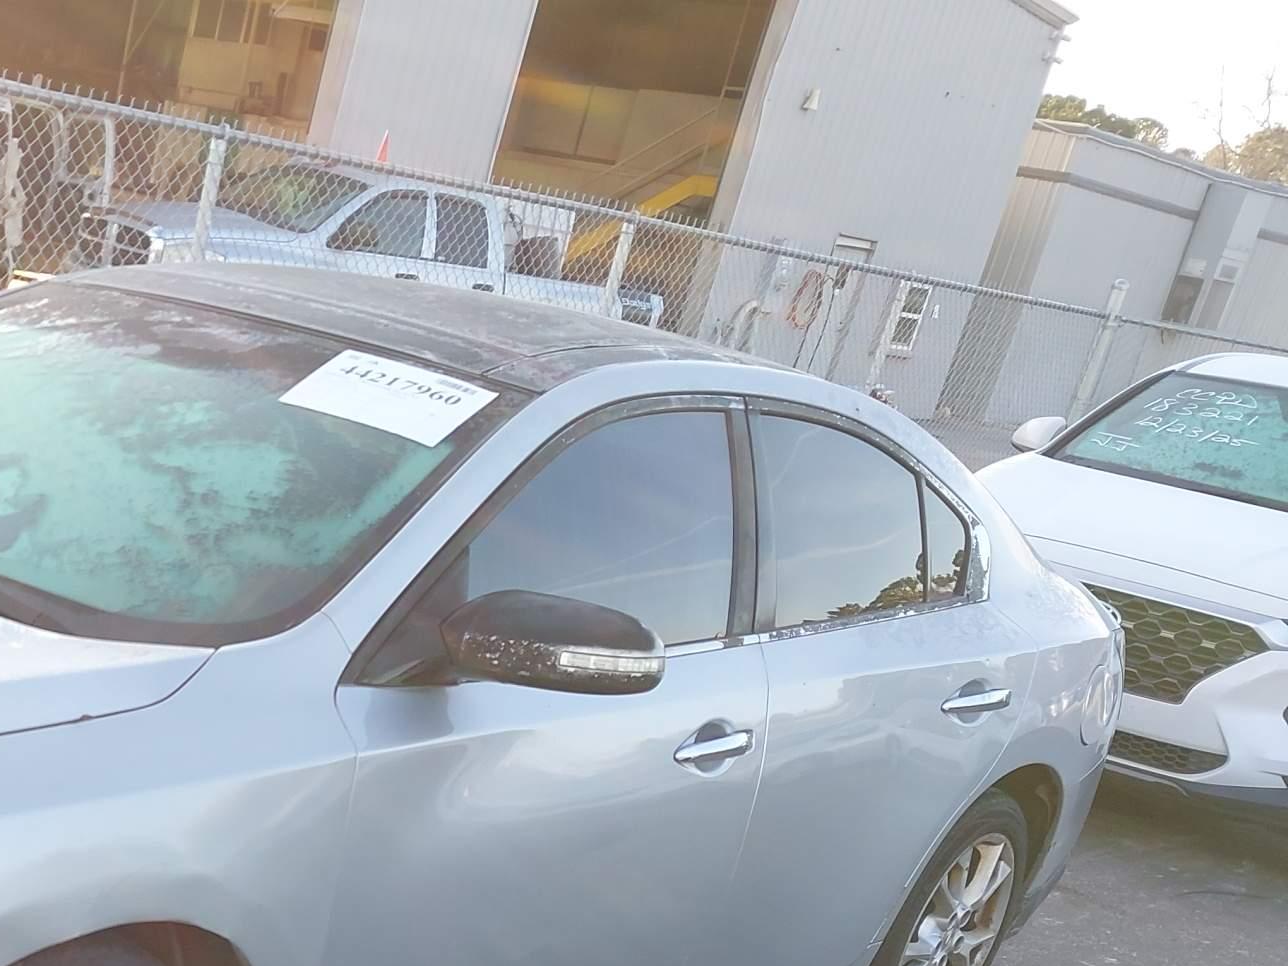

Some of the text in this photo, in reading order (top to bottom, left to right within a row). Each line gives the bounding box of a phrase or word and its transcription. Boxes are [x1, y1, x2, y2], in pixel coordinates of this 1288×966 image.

[339, 365, 462, 406] 44217960
[1143, 397, 1260, 426] 183221
[1133, 415, 1260, 448] 12/23/25
